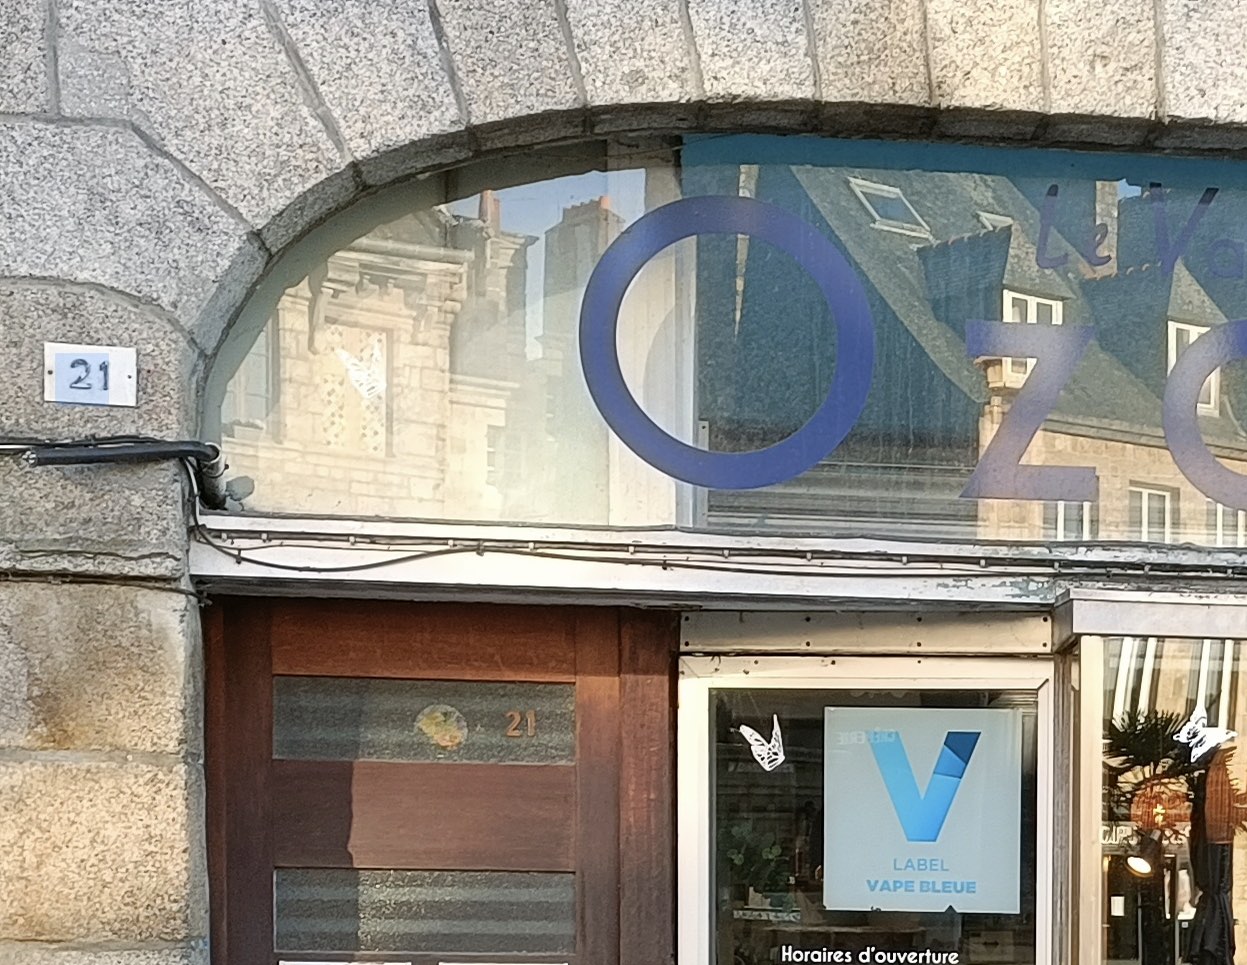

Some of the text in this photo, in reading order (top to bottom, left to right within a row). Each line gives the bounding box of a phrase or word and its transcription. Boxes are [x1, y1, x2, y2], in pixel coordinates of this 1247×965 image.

[1036, 184, 1112, 270] Le
[69, 358, 109, 391] 21
[505, 709, 537, 739] 21
[868, 731, 981, 842] V
[893, 858, 950, 872] LABEL
[866, 880, 977, 894] VAPE BLEUE
[781, 945, 960, 965] Horaires d'ouverture
